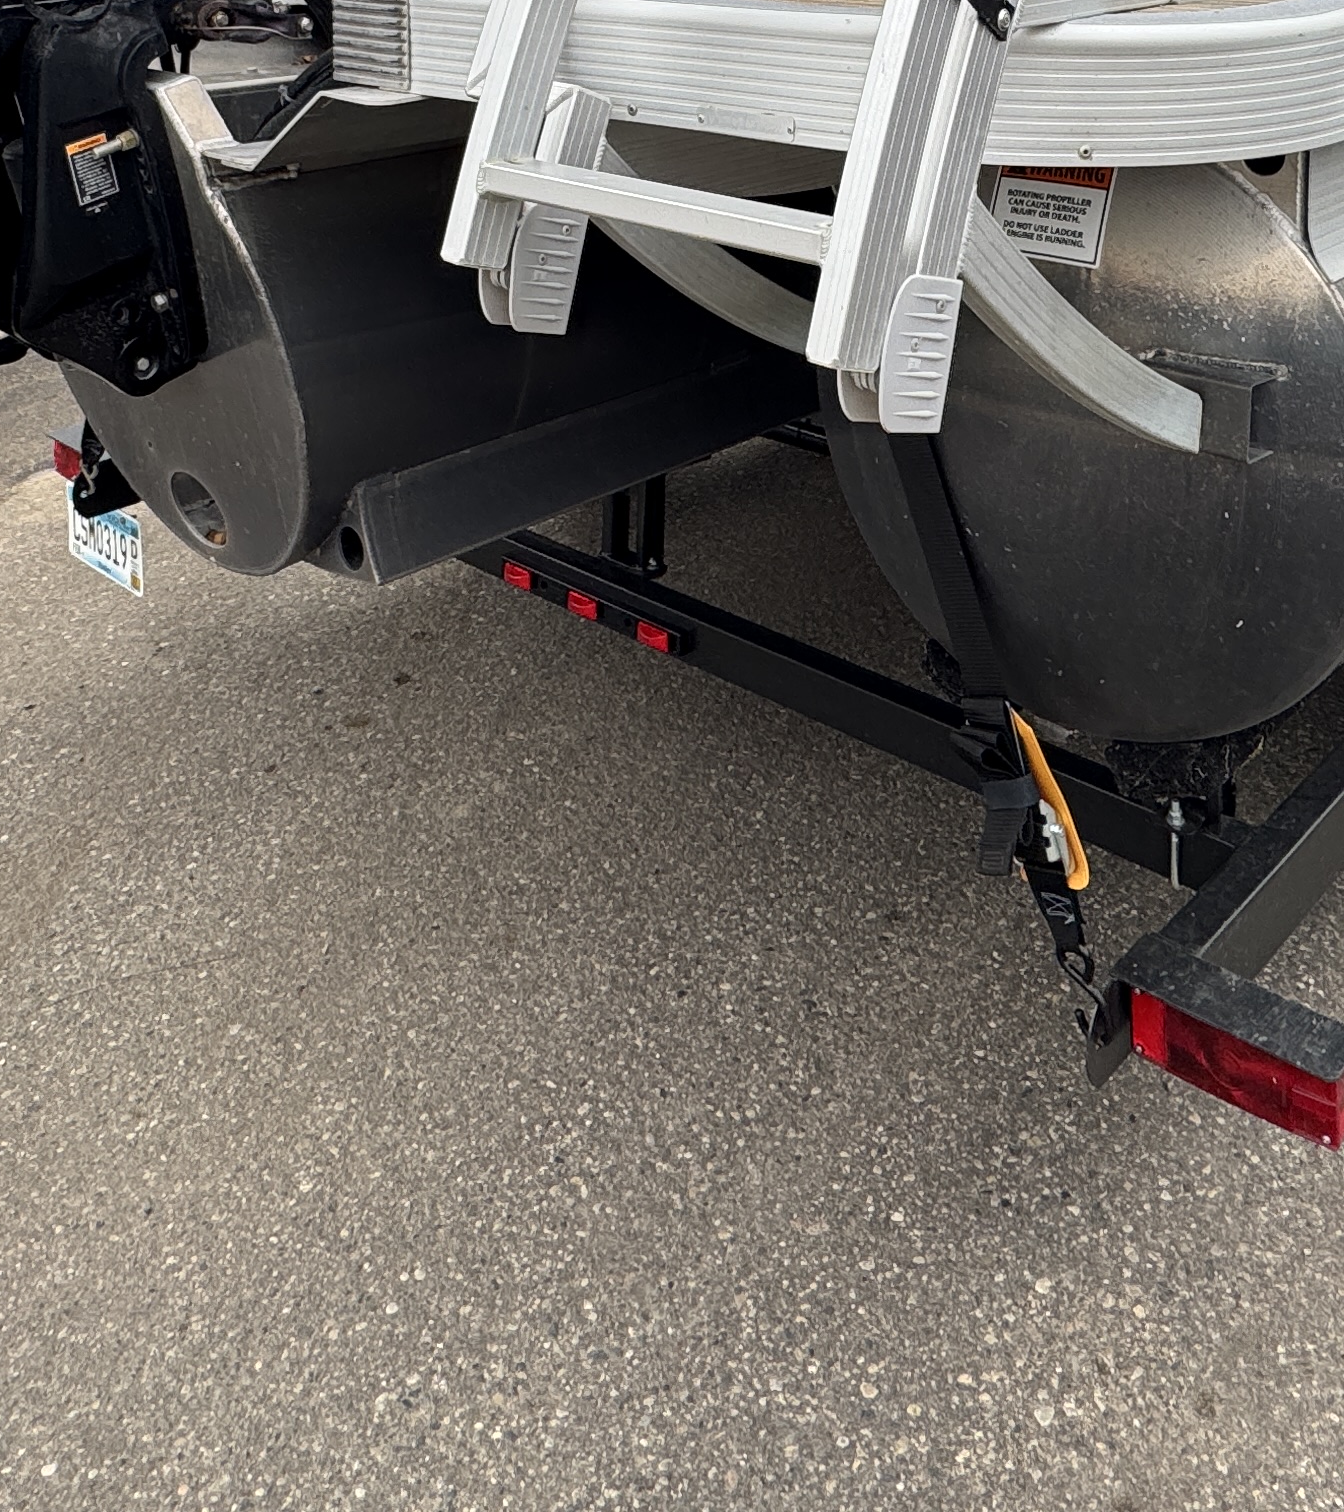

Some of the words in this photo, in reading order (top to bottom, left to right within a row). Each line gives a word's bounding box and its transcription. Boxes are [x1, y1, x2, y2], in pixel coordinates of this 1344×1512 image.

[1007, 188, 1045, 201] ROTATING
[1045, 194, 1092, 208] PROPELLER
[1008, 197, 1025, 207] CAN
[1025, 199, 1051, 210] CAUSE
[1052, 203, 1087, 216] SERIOUS
[1010, 206, 1037, 217] INJURY
[1038, 210, 1050, 220] OR
[1051, 212, 1081, 224] DEATH.
[1003, 219, 1015, 229] DO
[1016, 221, 1033, 231] NOT
[1033, 224, 1049, 234] USE
[1050, 225, 1084, 239] LADDER
[1006, 228, 1035, 240] ENGINE
[1036, 233, 1044, 242] IS
